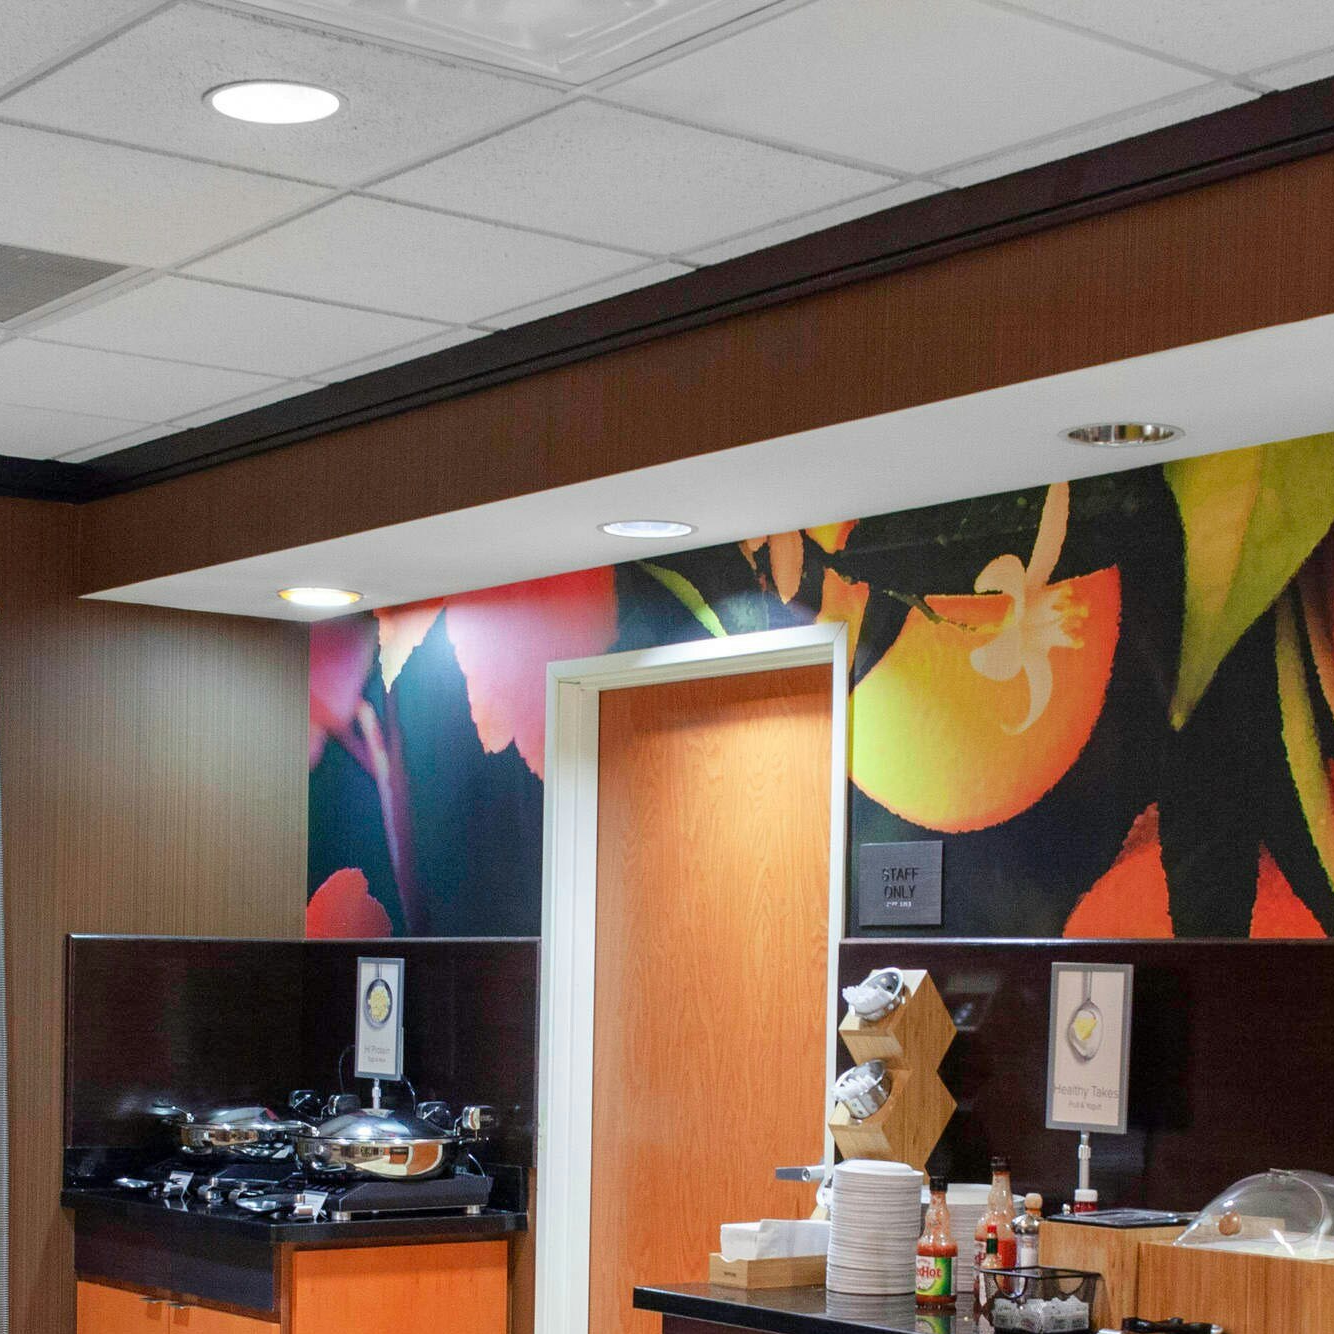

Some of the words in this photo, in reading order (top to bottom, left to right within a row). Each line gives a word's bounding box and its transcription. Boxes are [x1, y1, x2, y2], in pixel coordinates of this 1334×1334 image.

[882, 867, 920, 882] STAFF
[884, 885, 916, 899] ONLY
[1054, 1084, 1088, 1100] Healthy
[1090, 1085, 1120, 1099] Takes
